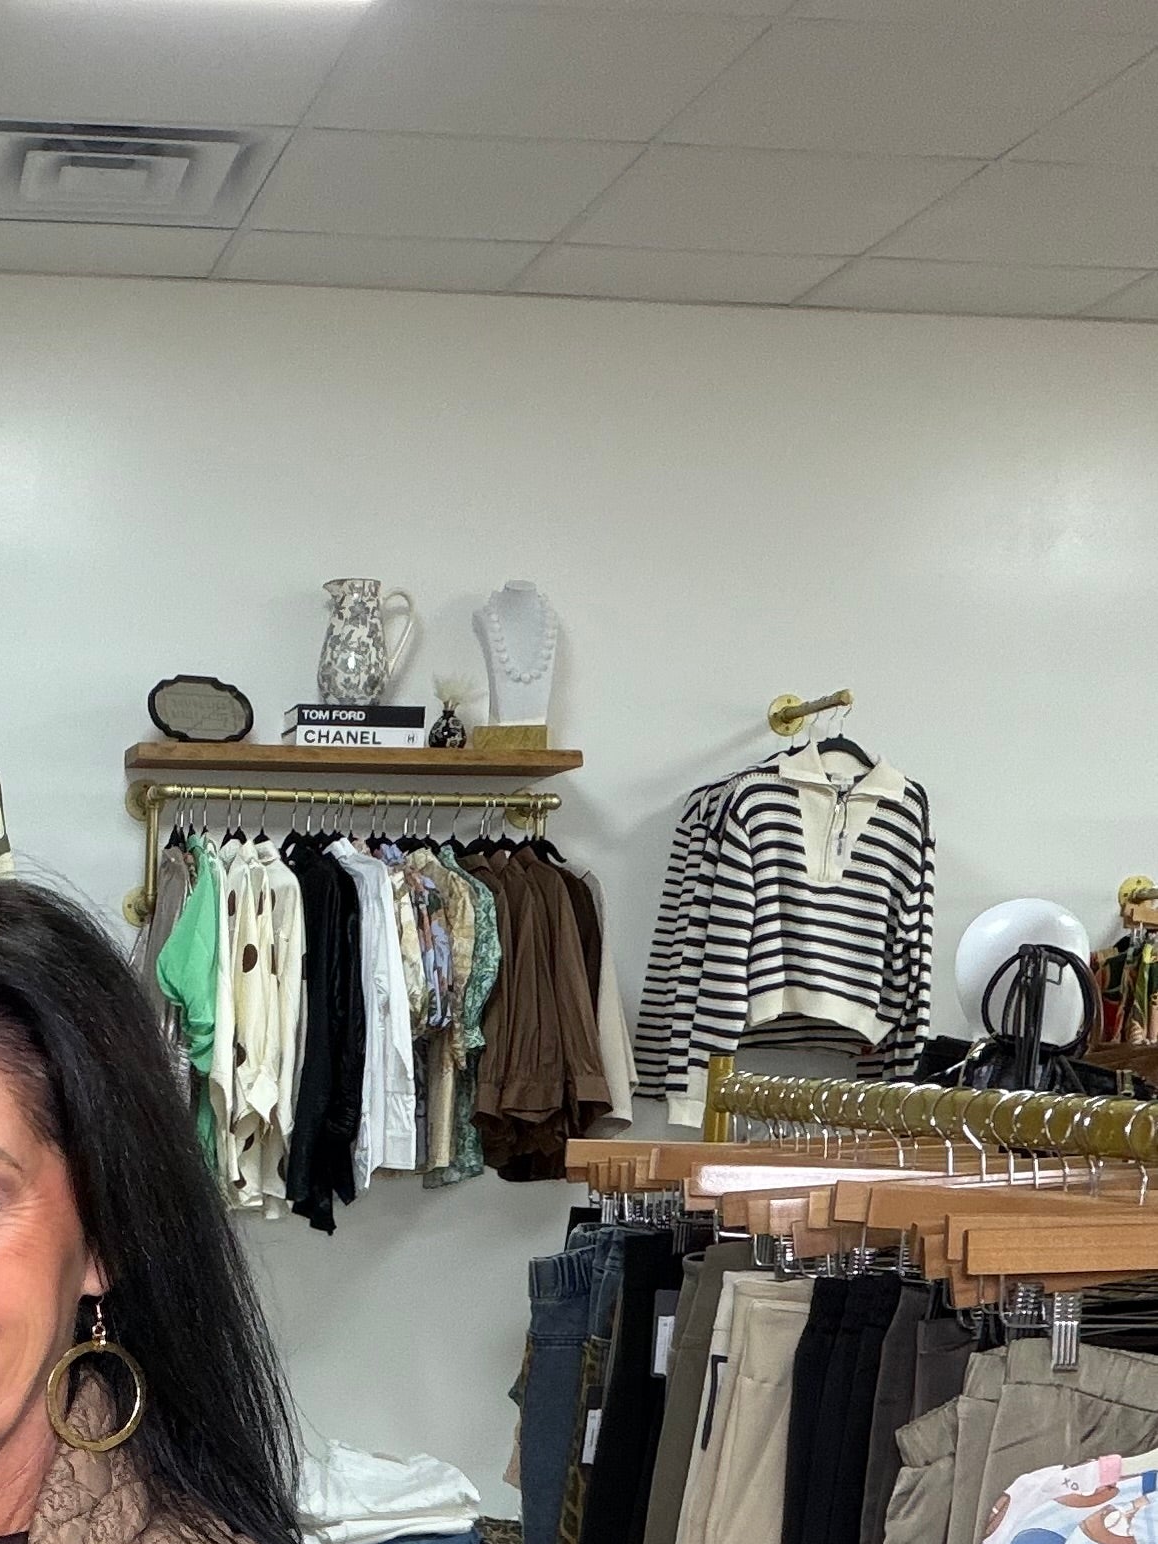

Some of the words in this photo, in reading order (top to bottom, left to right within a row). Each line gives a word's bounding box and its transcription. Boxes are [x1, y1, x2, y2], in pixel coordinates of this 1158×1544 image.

[302, 709, 330, 721] TOM
[332, 710, 366, 721] FORD
[304, 729, 382, 745] CHANEL
